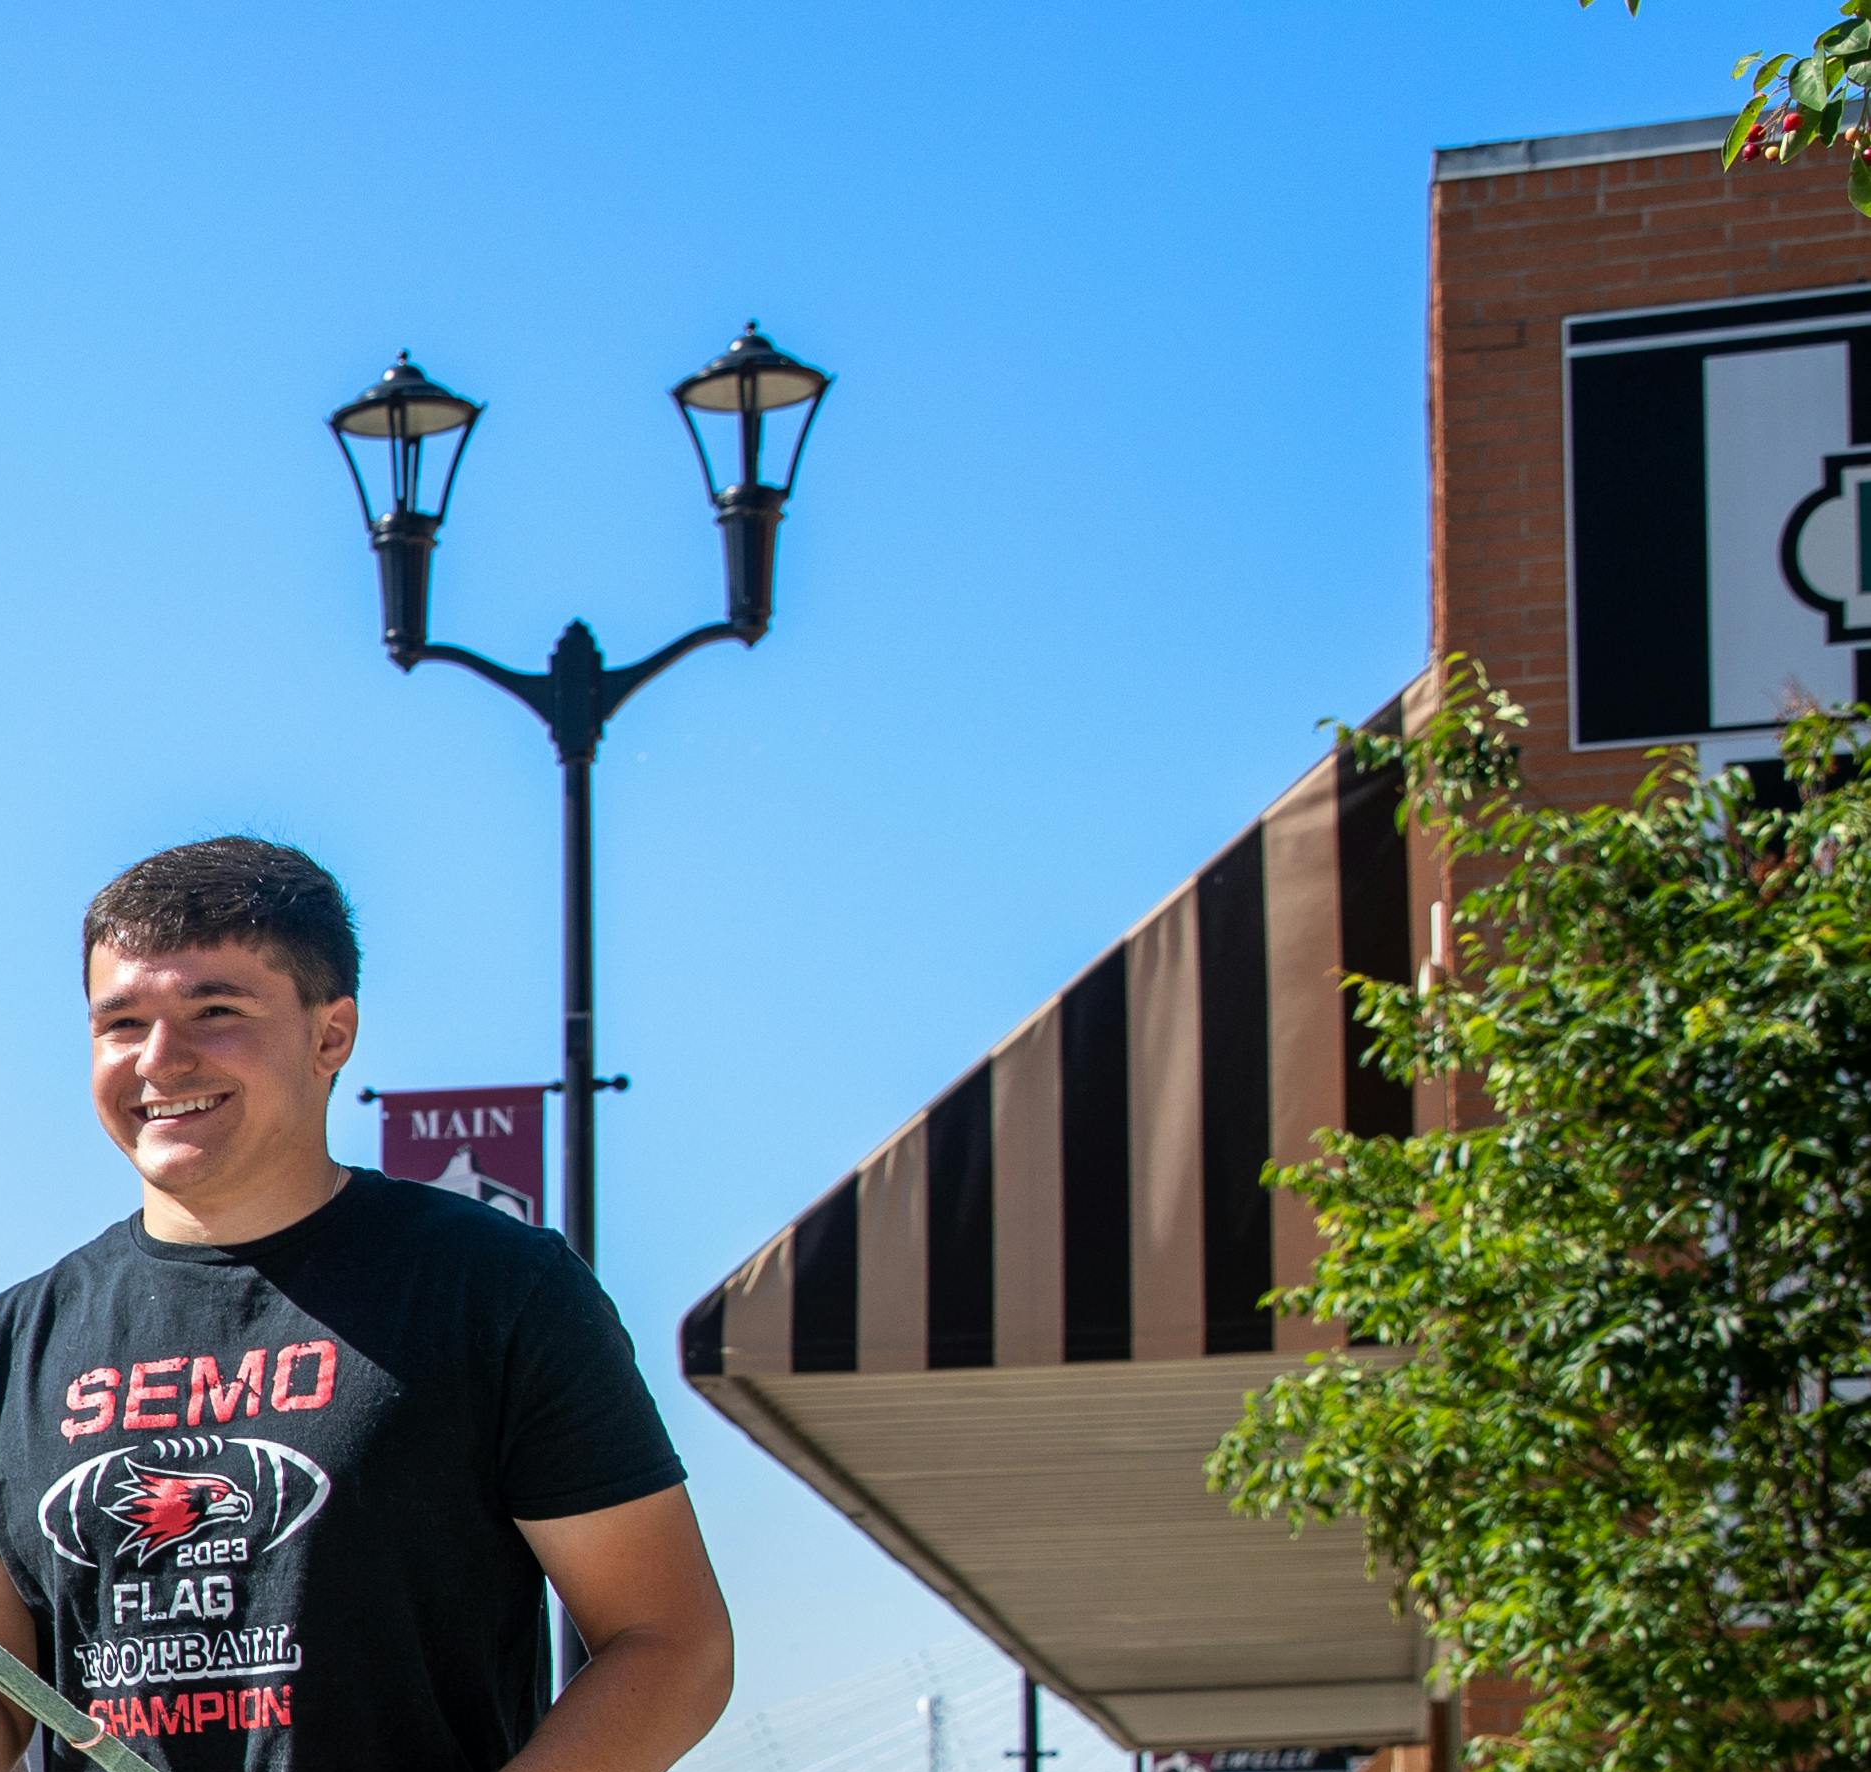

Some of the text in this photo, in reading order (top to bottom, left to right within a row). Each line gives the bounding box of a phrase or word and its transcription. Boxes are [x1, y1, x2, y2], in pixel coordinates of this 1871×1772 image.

[411, 1105, 516, 1141] MAIN
[60, 1339, 336, 1445] SEMO
[176, 1537, 248, 1567] 2023
[112, 1575, 235, 1625] FLAG
[73, 1623, 302, 1689] FOOTBALL
[89, 1684, 293, 1739] CHAMPION
